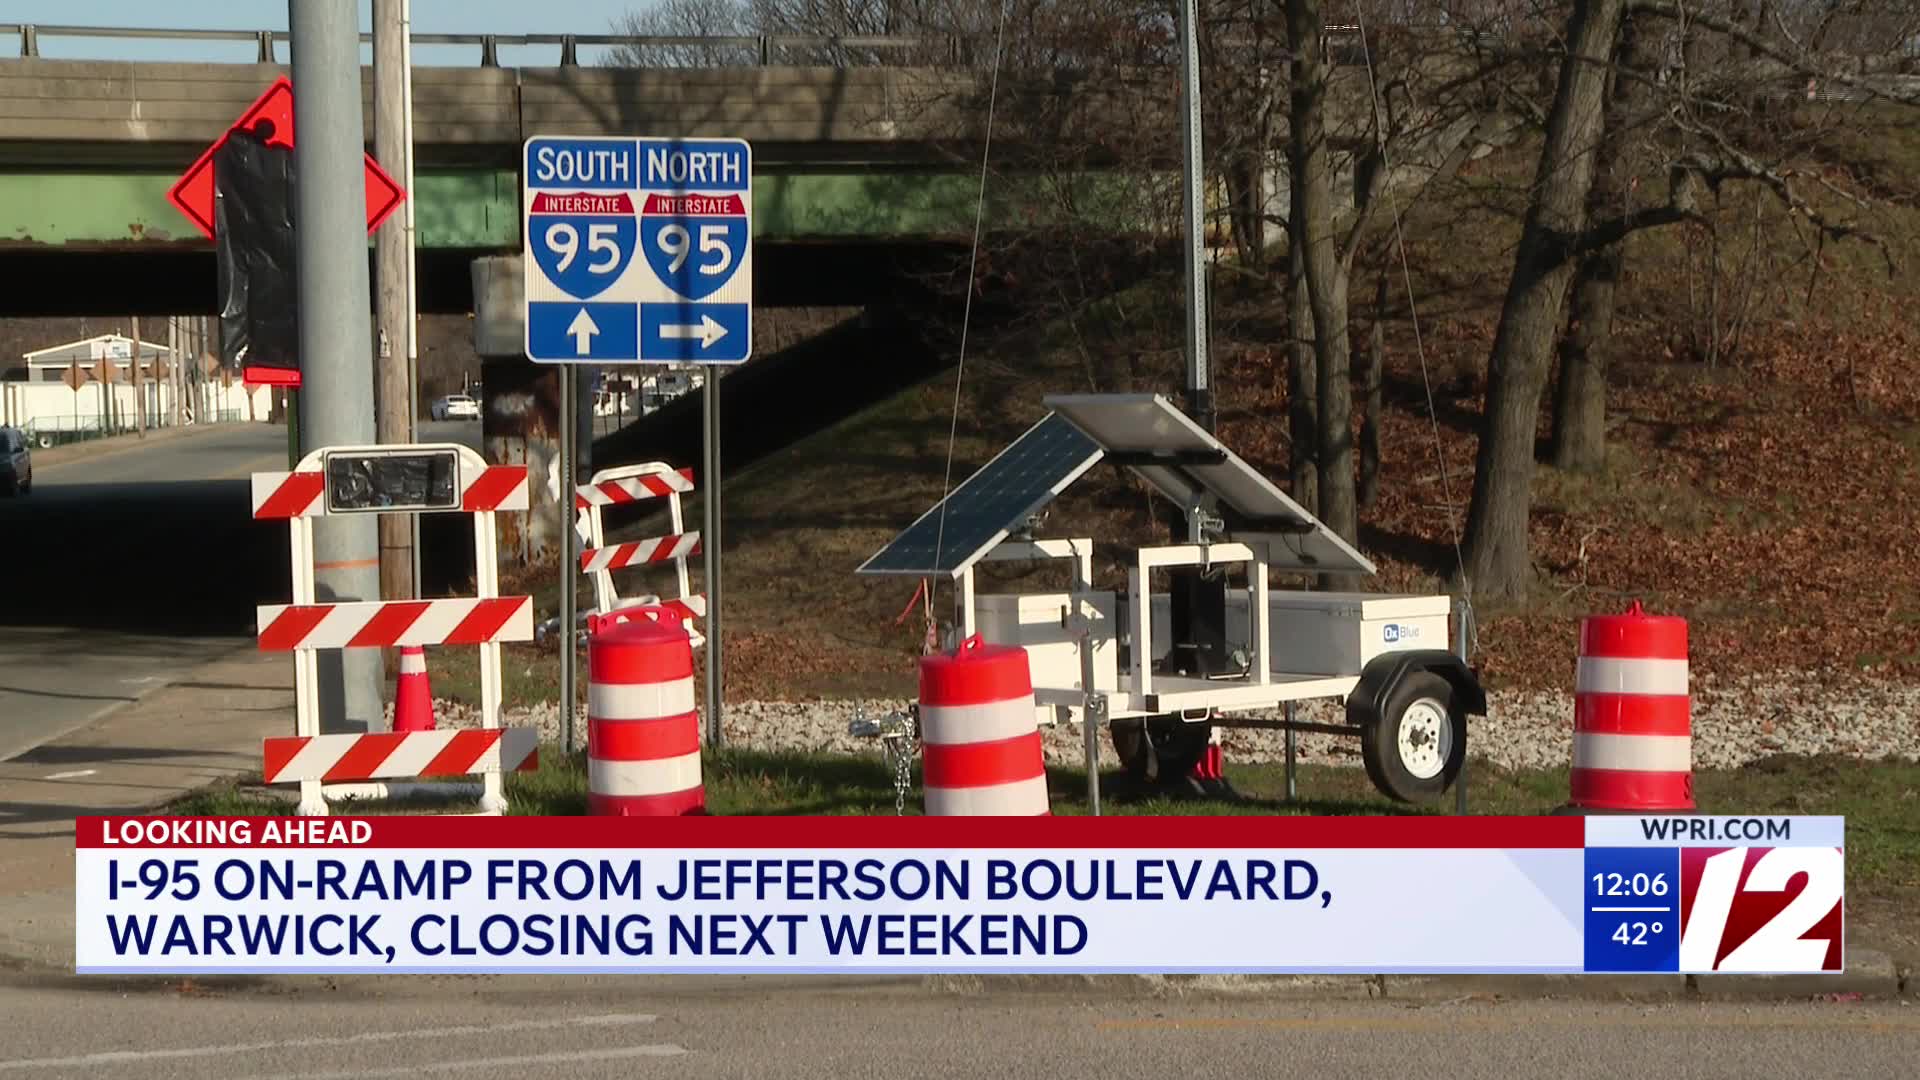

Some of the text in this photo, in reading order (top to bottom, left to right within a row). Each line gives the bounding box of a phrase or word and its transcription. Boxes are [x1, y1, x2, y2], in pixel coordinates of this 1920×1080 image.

[536, 147, 629, 182] SOUTH
[647, 148, 740, 183] NORTH
[545, 198, 620, 212] INTERSTATE
[656, 199, 731, 213] INTERSTATE
[545, 223, 621, 274] 95
[656, 224, 732, 275] 95
